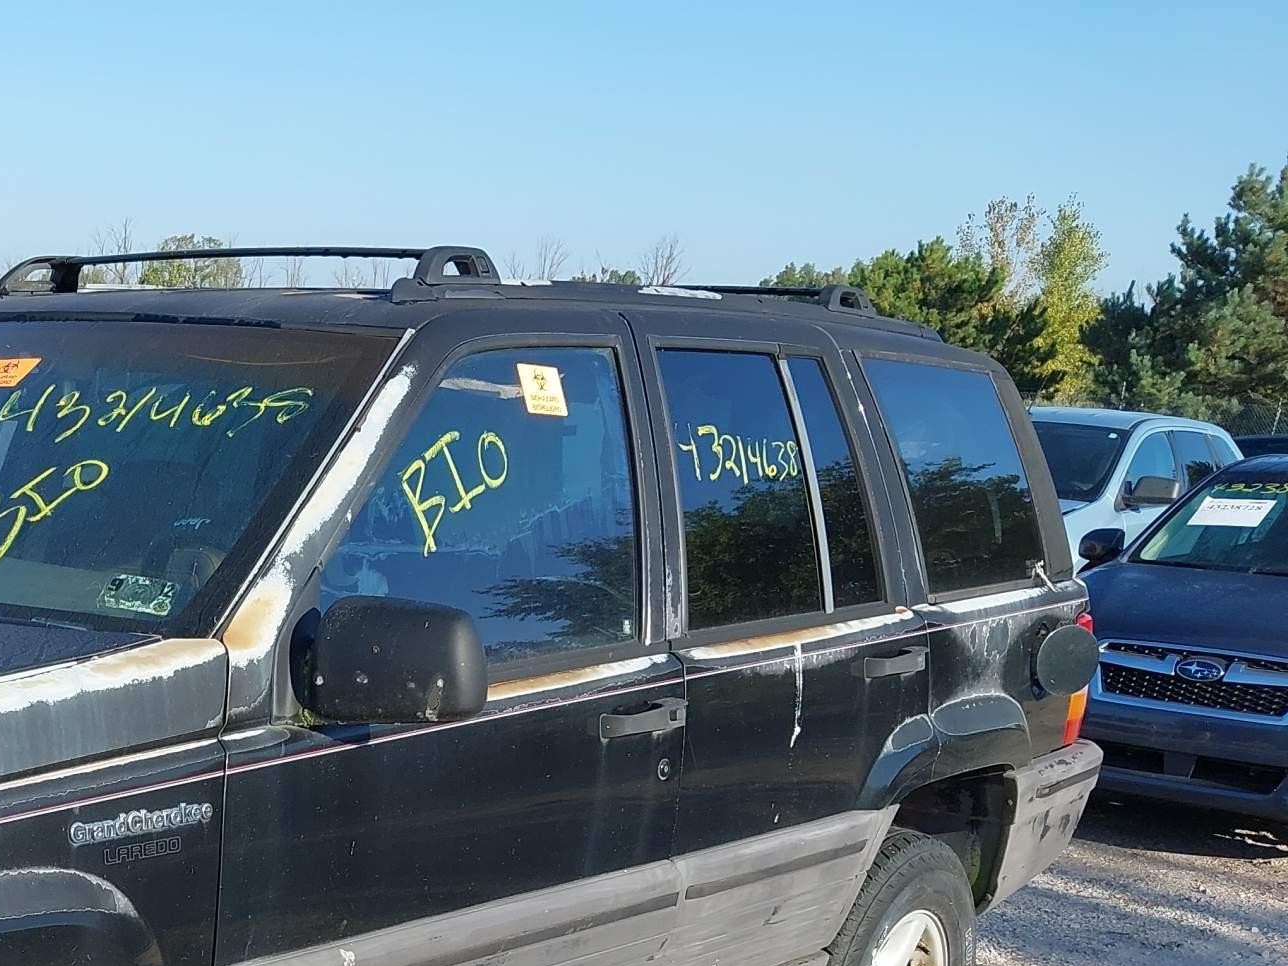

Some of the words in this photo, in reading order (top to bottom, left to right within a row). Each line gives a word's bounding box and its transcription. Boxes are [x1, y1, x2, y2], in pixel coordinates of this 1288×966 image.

[674, 423, 799, 486] 43214638
[396, 430, 508, 557] BIO
[104, 836, 181, 865] LAREDO
